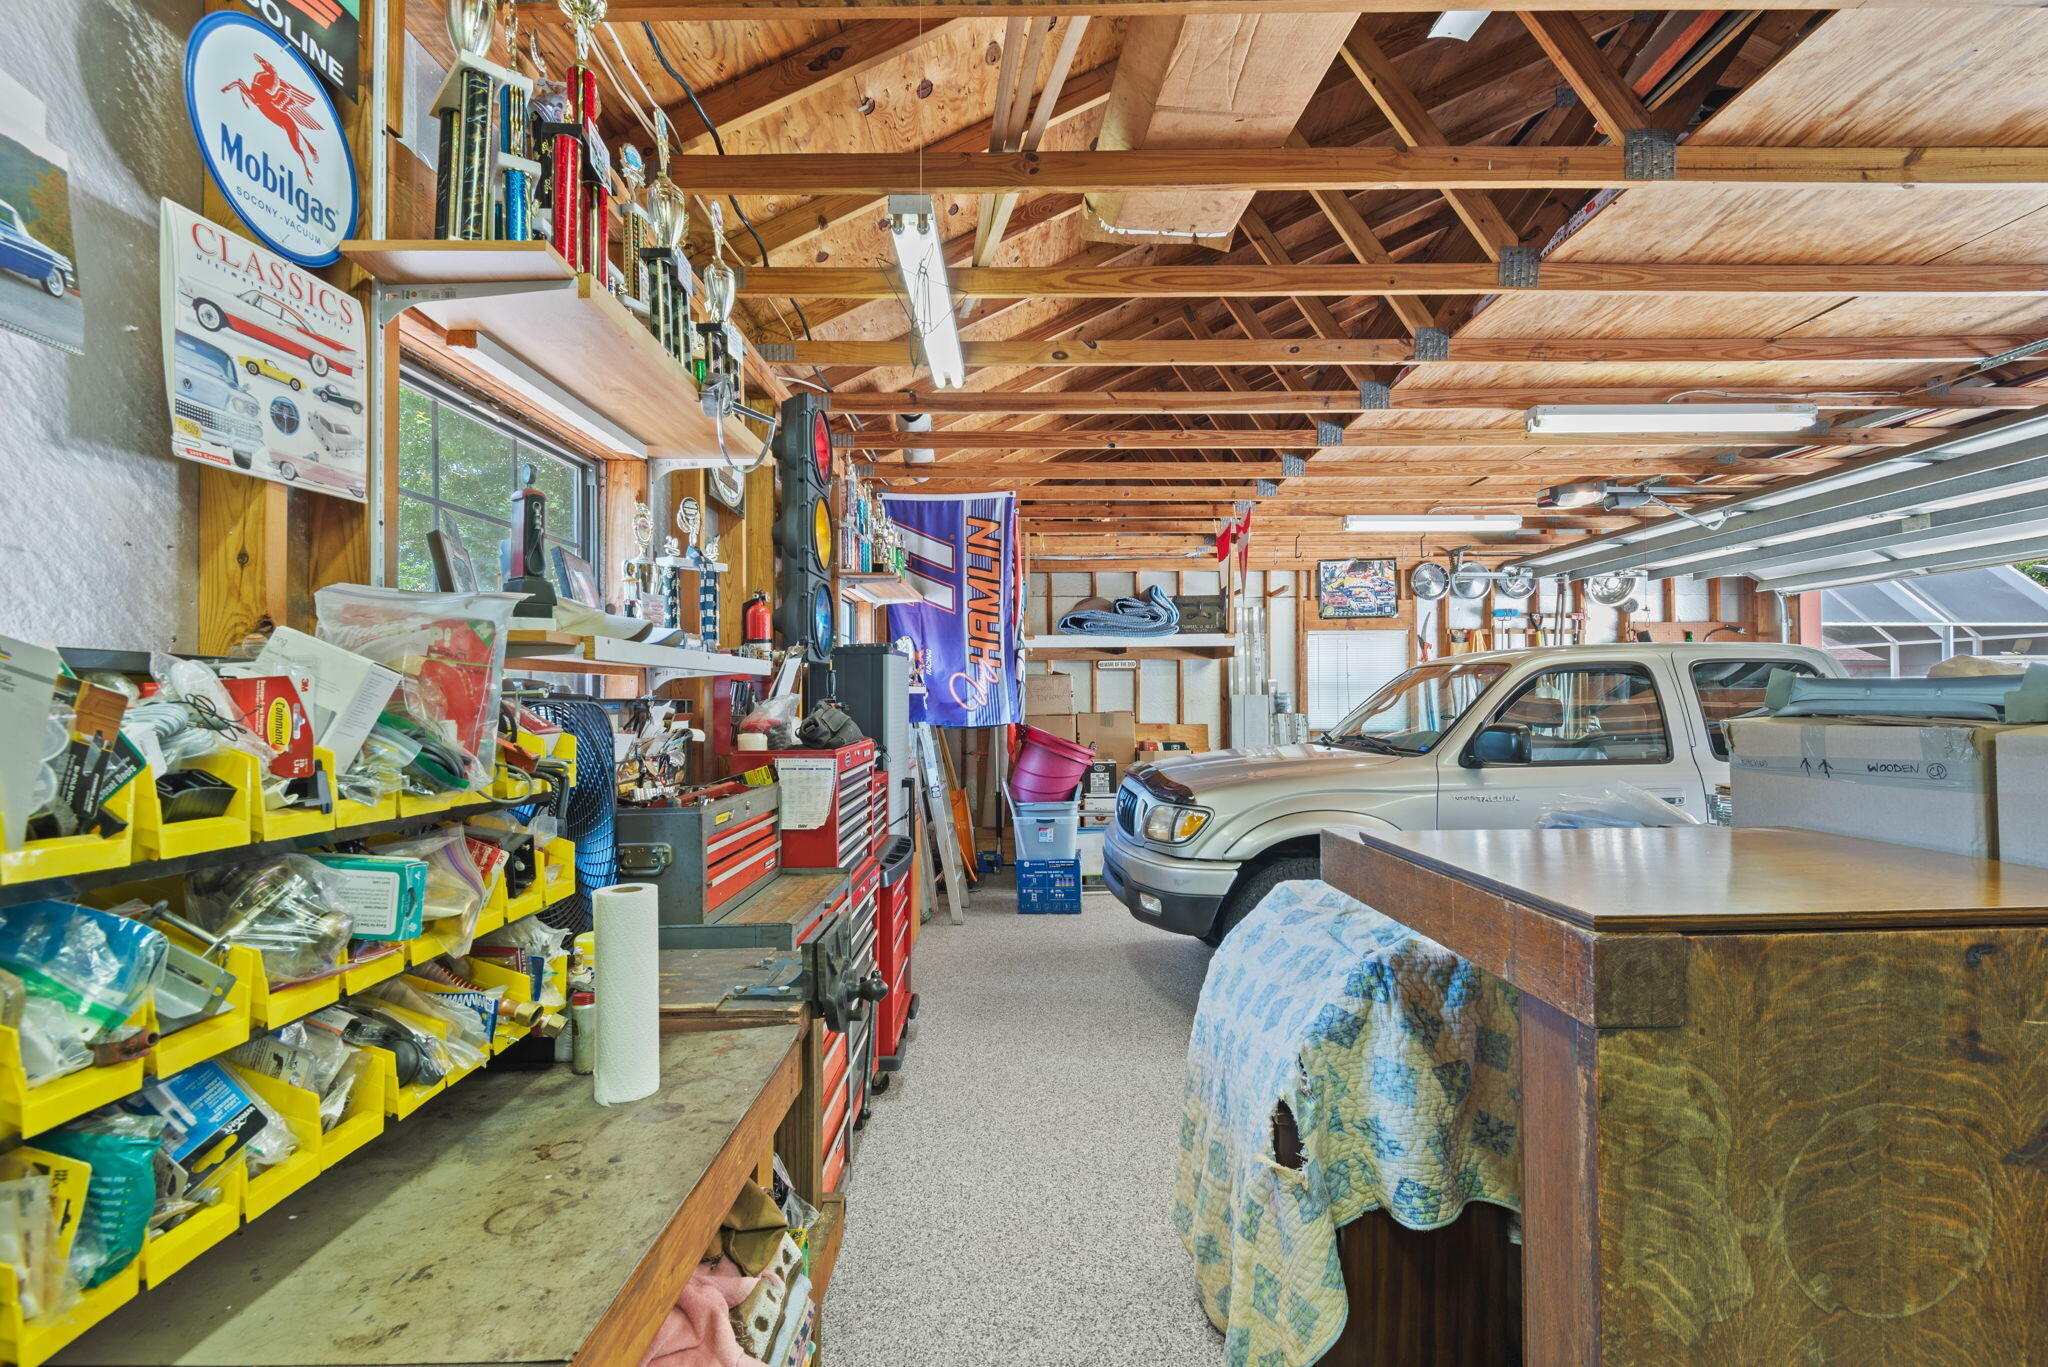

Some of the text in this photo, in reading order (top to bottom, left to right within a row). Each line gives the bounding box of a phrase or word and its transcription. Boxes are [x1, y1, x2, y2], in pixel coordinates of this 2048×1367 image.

[220, 122, 337, 233] Mobilgas
[192, 223, 354, 325] CLASSICS
[966, 515, 1002, 669] HAMLIN
[925, 648, 933, 676] RACING
[300, 677, 310, 693] 3M
[274, 701, 286, 746] Command
[1866, 763, 1920, 775] WOODEN
